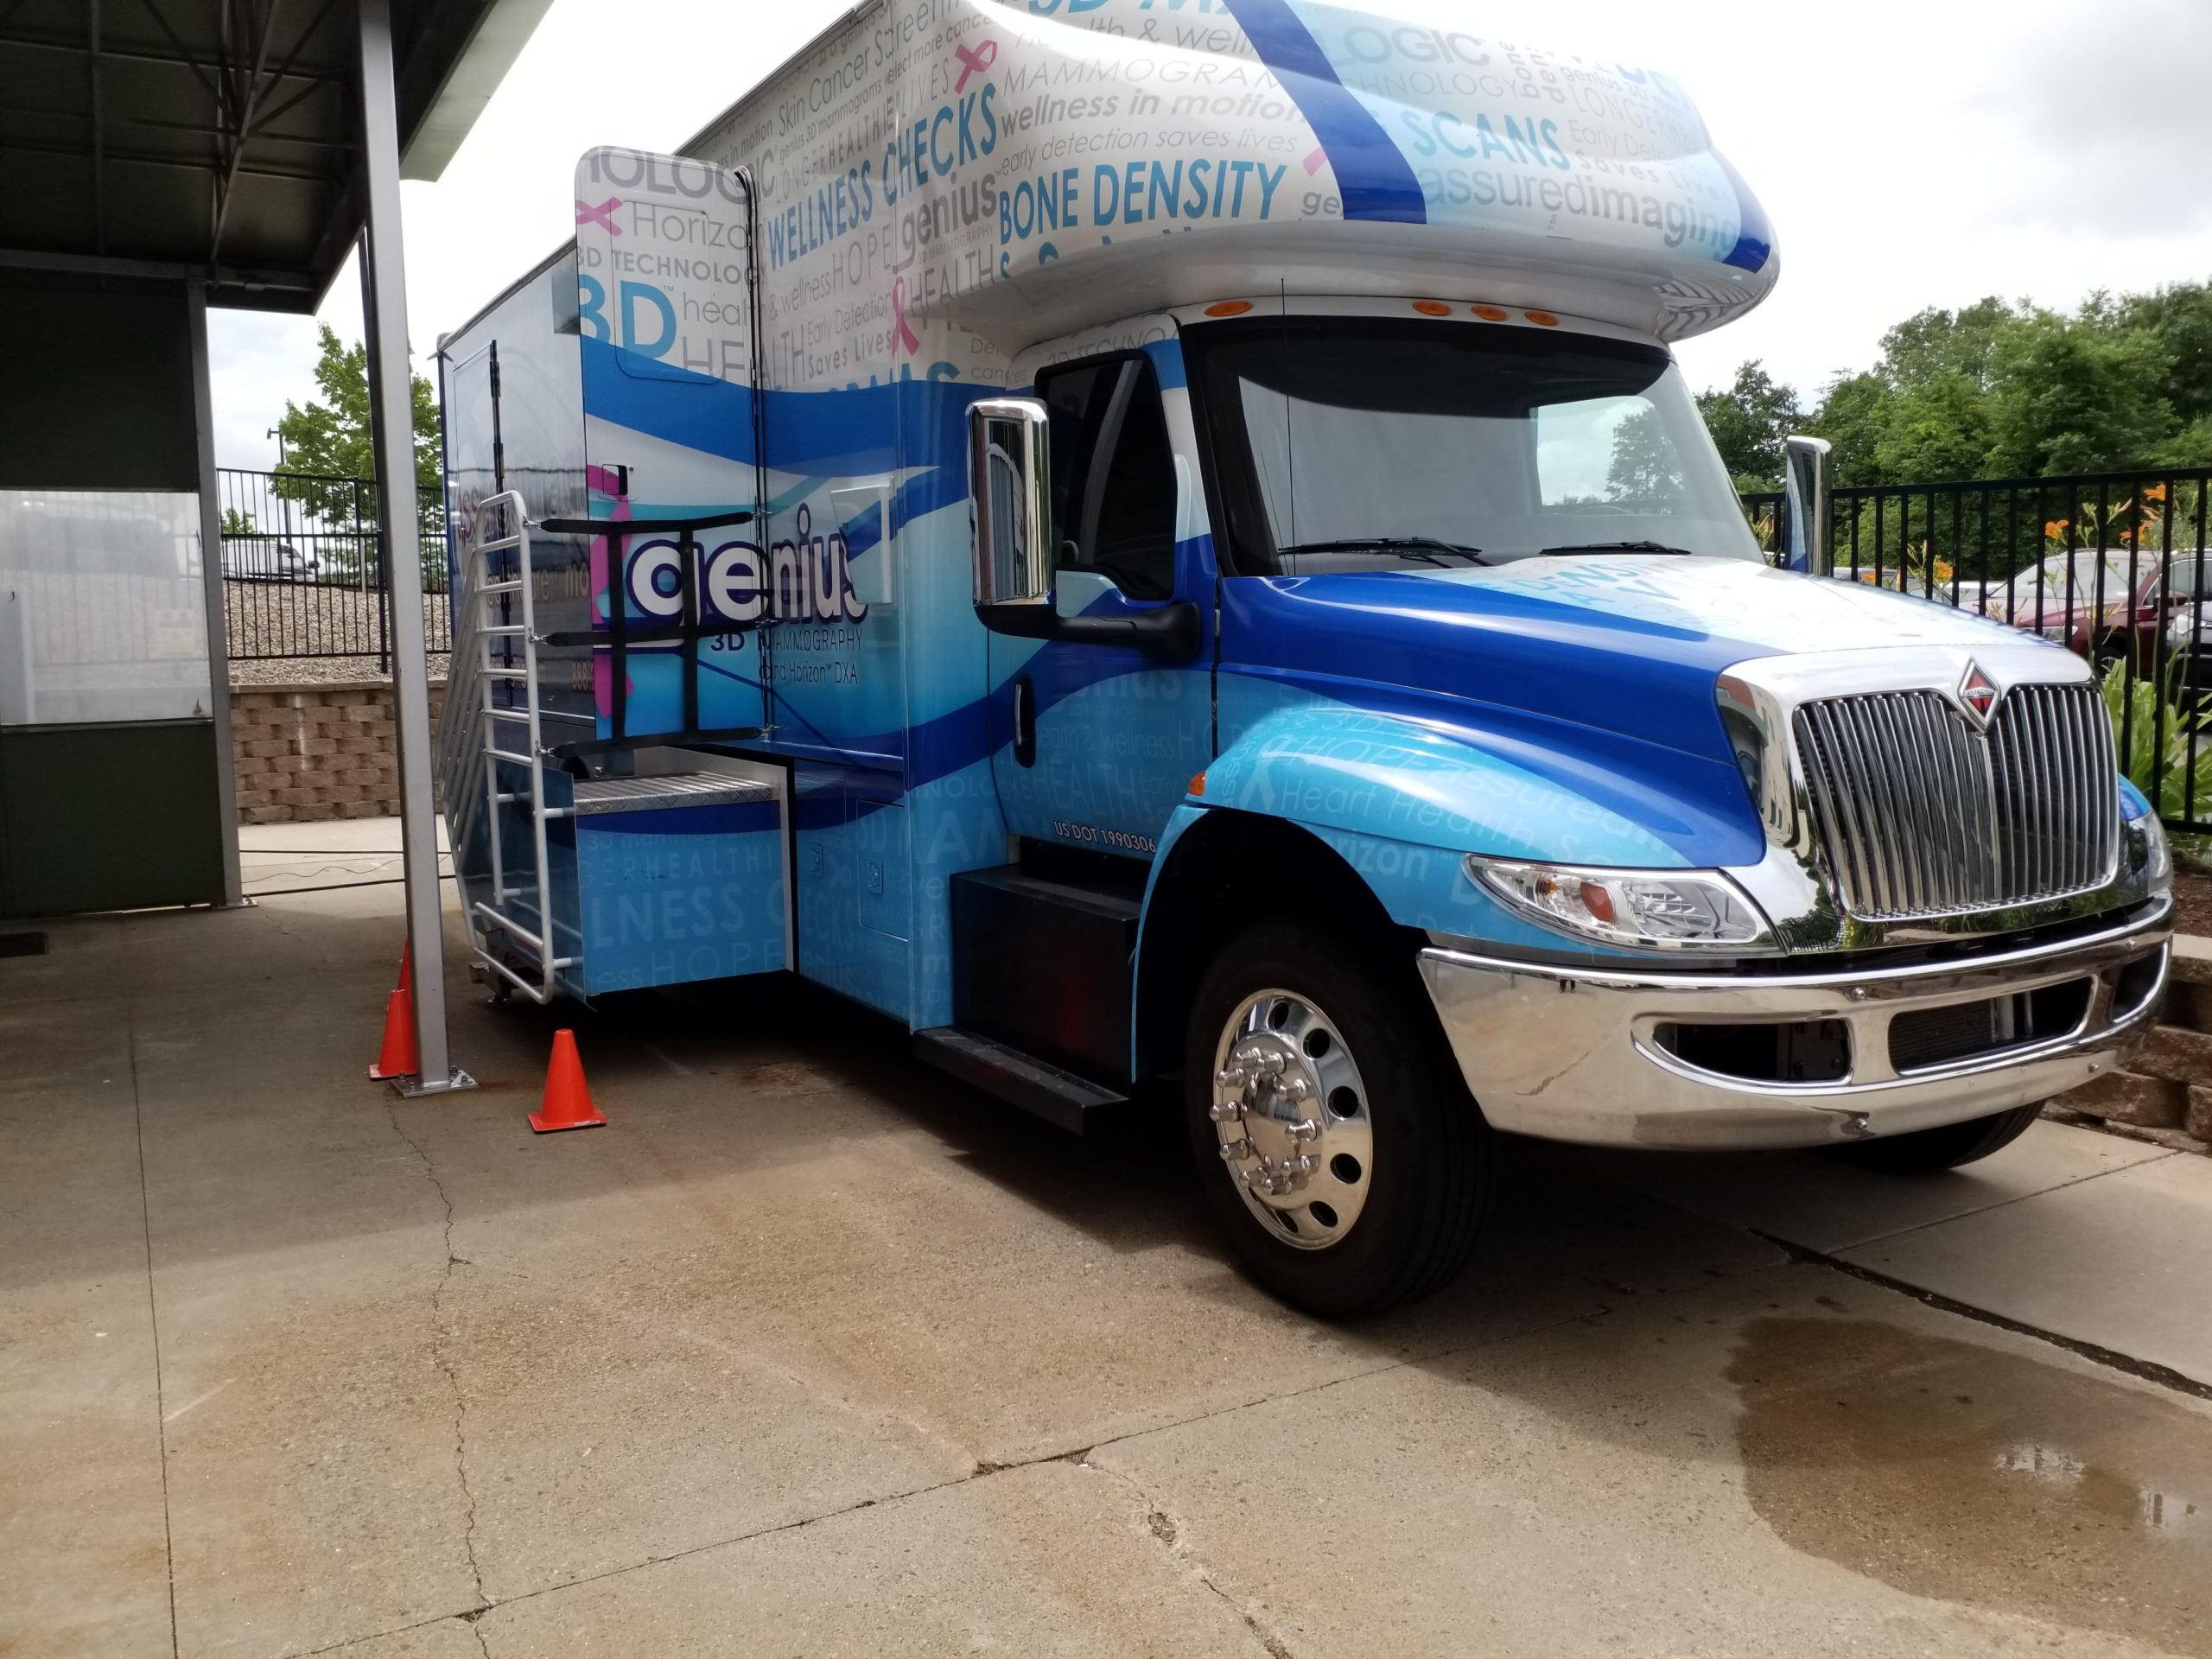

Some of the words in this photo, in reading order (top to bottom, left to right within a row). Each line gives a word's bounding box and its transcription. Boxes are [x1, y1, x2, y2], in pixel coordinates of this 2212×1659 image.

[1137, 17, 1160, 43] &
[778, 127, 805, 165] genius
[913, 33, 944, 66] more
[946, 12, 995, 43] cance
[779, 95, 805, 137] Skin
[810, 46, 870, 113] Cancer
[1001, 92, 1122, 138] wellness
[1127, 88, 1160, 116] in
[1169, 92, 1306, 124] motion
[741, 118, 774, 158] motion
[1001, 143, 1038, 177] early
[1041, 127, 1148, 161] detection
[1154, 128, 1229, 149] saves
[1236, 126, 1299, 153] lives
[1400, 110, 1571, 171] SCANS
[1567, 119, 1618, 156] Early
[767, 159, 874, 272] WELLNESS
[882, 82, 998, 207] CHECKS
[999, 167, 1080, 246] BONE
[1093, 157, 1288, 226] DENSITY
[632, 201, 766, 251] Horizon
[893, 170, 998, 275] genius
[611, 250, 767, 285] TECHNOLOGY
[782, 270, 831, 315] wellness
[832, 224, 893, 295] HOPE
[909, 243, 997, 316] HEALTH
[578, 273, 677, 359] 3D
[807, 316, 832, 347] Early
[835, 290, 893, 335] Detection
[710, 631, 746, 652] 3D
[758, 628, 864, 652] MAMMOGRAPHY
[789, 661, 827, 683] Horizon
[834, 660, 858, 684] DXA
[1281, 779, 1378, 817] Heart
[1053, 821, 1070, 837] US
[1072, 823, 1098, 843] DOT
[1101, 828, 1157, 853] 1990306
